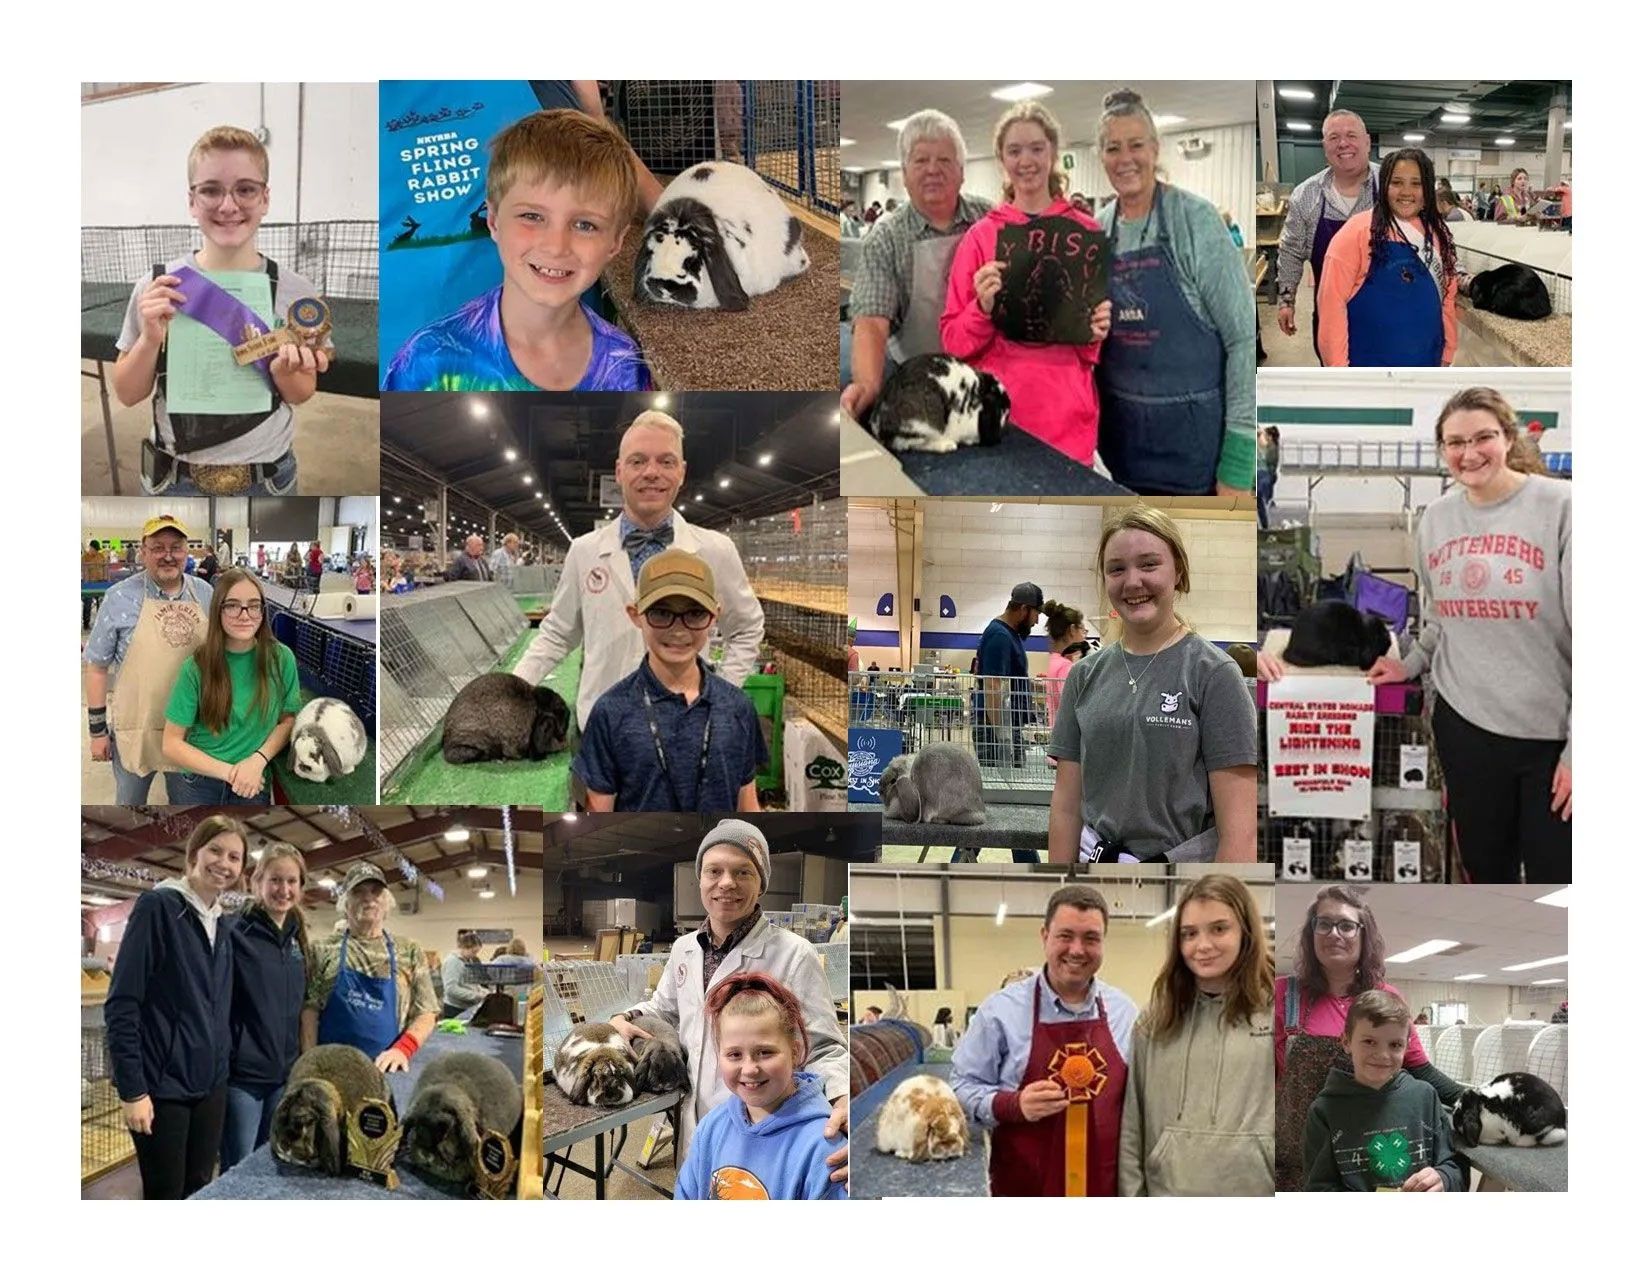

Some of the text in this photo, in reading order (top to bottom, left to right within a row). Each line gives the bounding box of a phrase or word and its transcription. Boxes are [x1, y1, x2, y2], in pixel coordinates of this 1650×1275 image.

[400, 138, 479, 162] SPRING
[411, 154, 472, 175] FLING
[407, 167, 481, 191] RABBIT
[414, 183, 472, 204] SHOW
[1428, 534, 1545, 571] WITTENBERG
[1504, 568, 1525, 585] 45
[1289, 723, 1352, 735] RIDE THE
[1275, 764, 1371, 779] BEST IN SHOW
